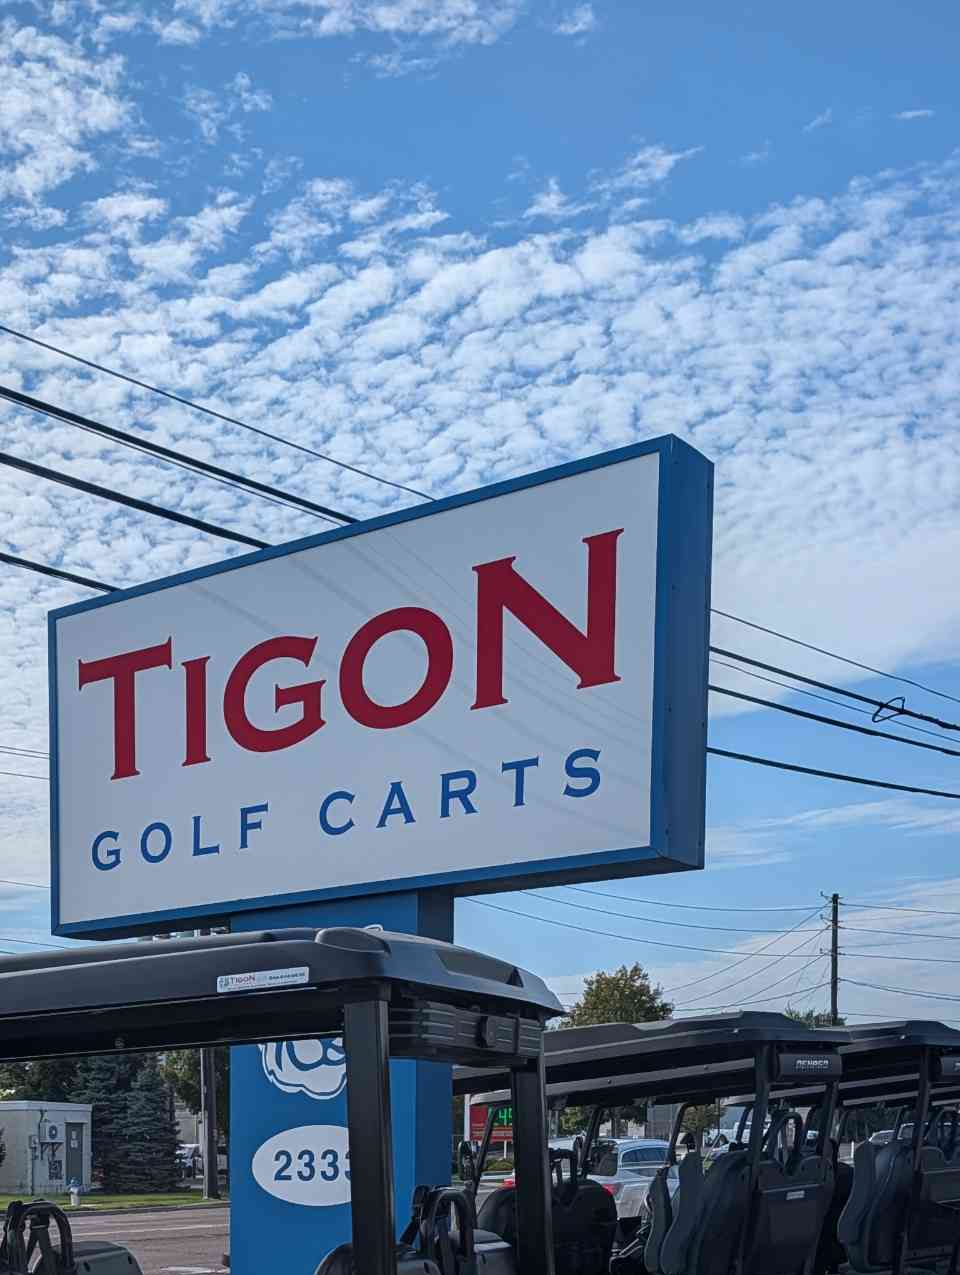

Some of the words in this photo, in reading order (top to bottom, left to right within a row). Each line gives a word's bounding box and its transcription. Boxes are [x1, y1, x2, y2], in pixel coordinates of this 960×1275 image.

[78, 527, 625, 781] TIGON
[91, 802, 269, 872] GOLF
[319, 748, 602, 836] CARTS
